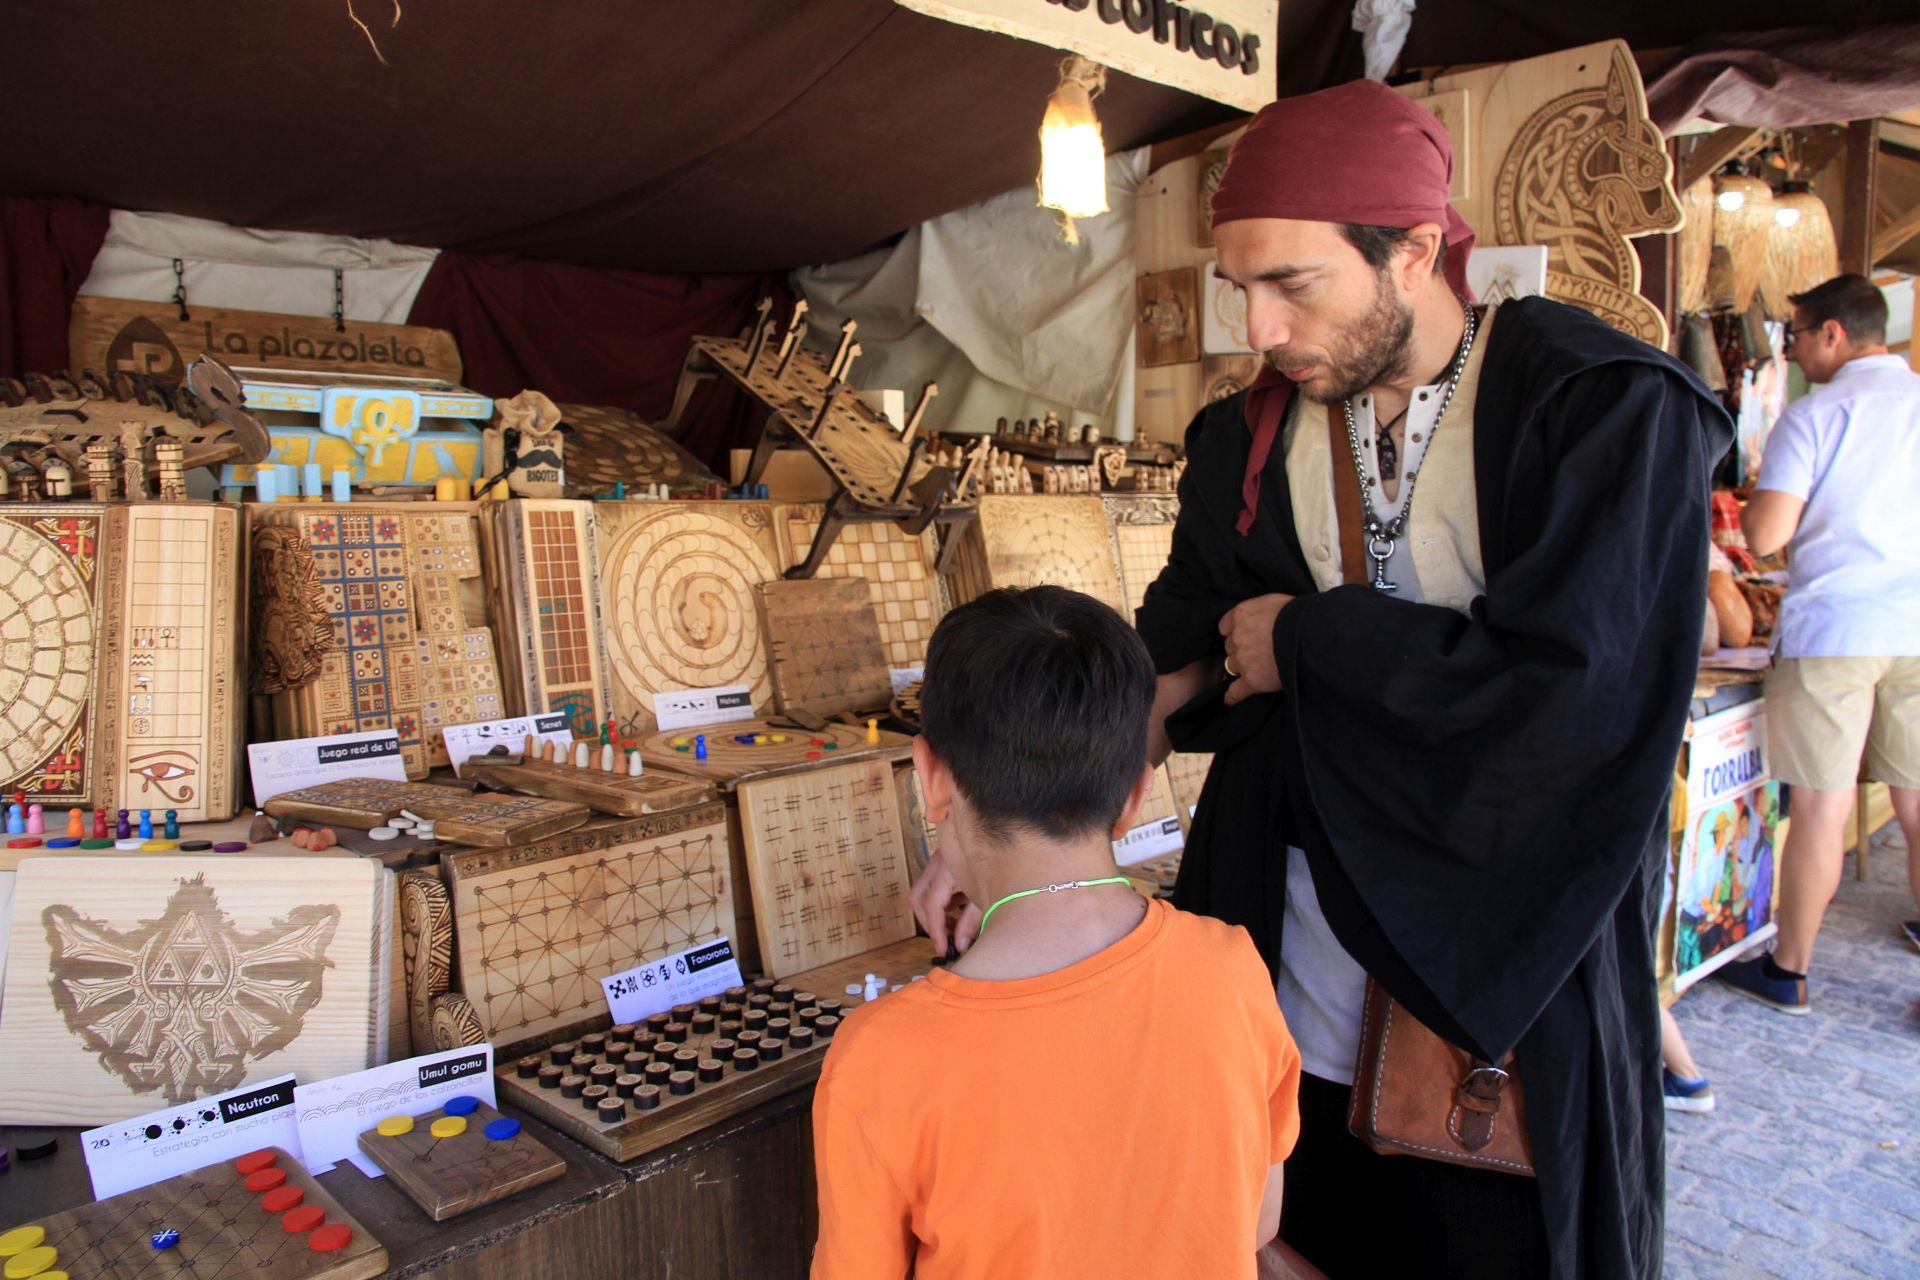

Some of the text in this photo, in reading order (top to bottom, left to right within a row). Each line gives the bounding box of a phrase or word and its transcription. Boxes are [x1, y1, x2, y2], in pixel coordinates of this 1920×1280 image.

[204, 321, 425, 367] La plazoleta
[540, 720, 562, 730] Senet
[320, 740, 398, 759] Juego real de UR
[1703, 747, 1763, 798] TORRALBA
[691, 947, 730, 966] Fanorona
[420, 1060, 482, 1081] Umul gomu
[227, 1092, 280, 1115] Neutron
[356, 1107, 366, 1117] El
[367, 1101, 397, 1114] juego
[399, 1095, 412, 1105] de
[414, 1091, 429, 1100] los
[152, 1108, 296, 1158] Estrategia con mucho piqu
